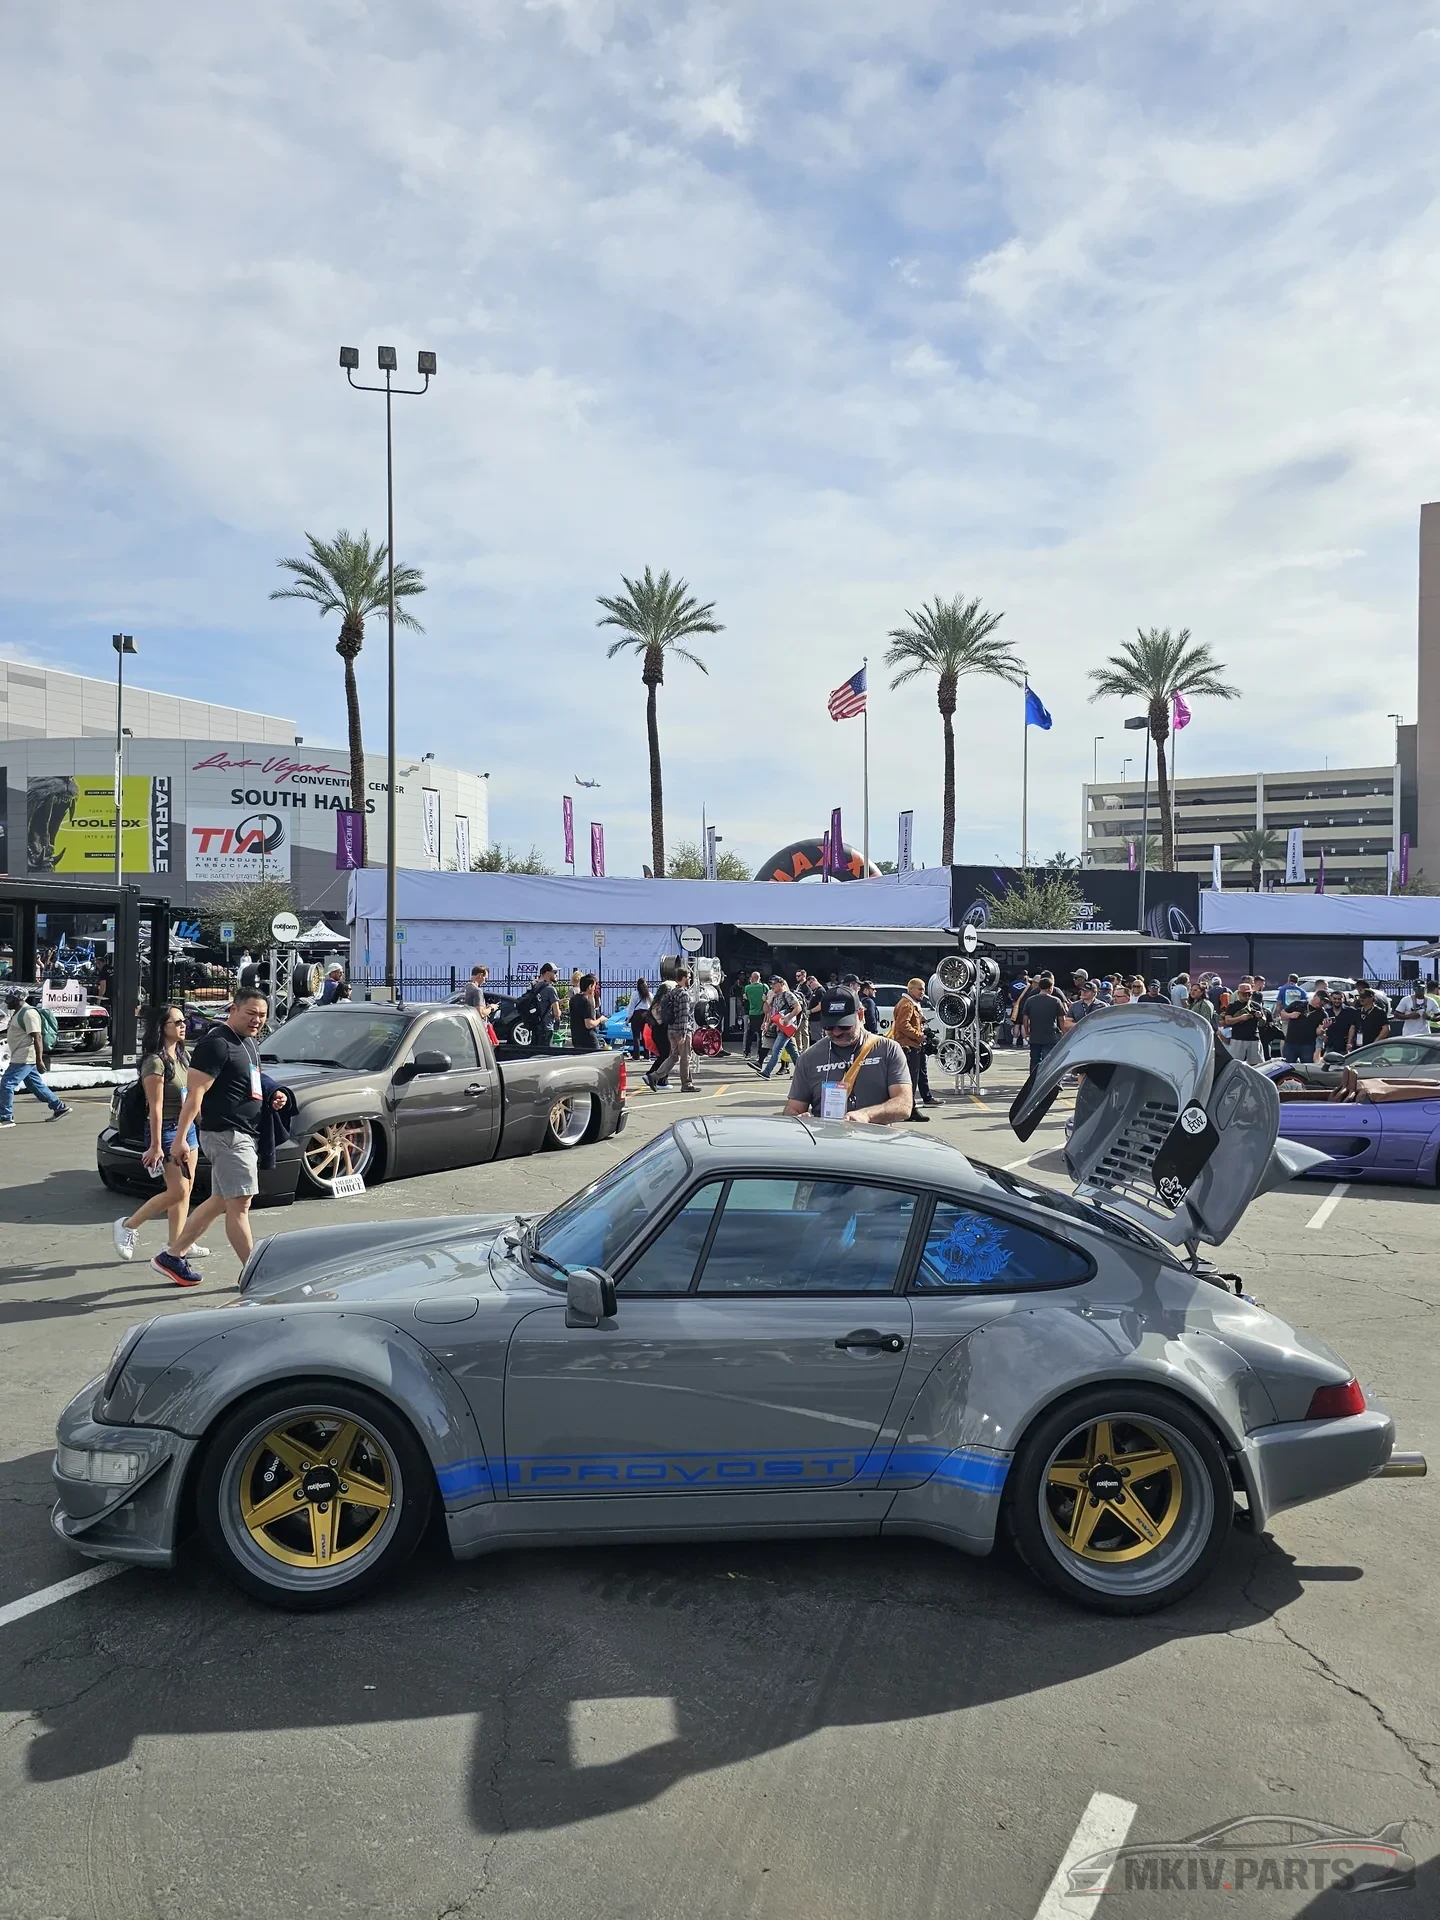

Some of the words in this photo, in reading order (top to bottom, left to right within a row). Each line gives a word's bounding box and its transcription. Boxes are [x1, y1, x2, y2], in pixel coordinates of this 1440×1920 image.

[192, 752, 262, 772] Las
[261, 756, 351, 784] Vegas
[291, 774, 350, 788] CONVENTI
[368, 782, 404, 794] CENER
[231, 788, 306, 807] SOUTH
[314, 793, 375, 813] HALS
[156, 775, 169, 873] CARLYLE
[191, 827, 273, 855] TIA
[1088, 922, 1110, 931] TIRE
[48, 993, 73, 1002] Mobil
[816, 1063, 846, 1073] TOYO
[1183, 1114, 1190, 1123] I
[335, 1182, 363, 1194] FORCE
[530, 1458, 851, 1483] PROVOST
[307, 1482, 331, 1491] rotiform
[1096, 1480, 1118, 1488] rotiform
